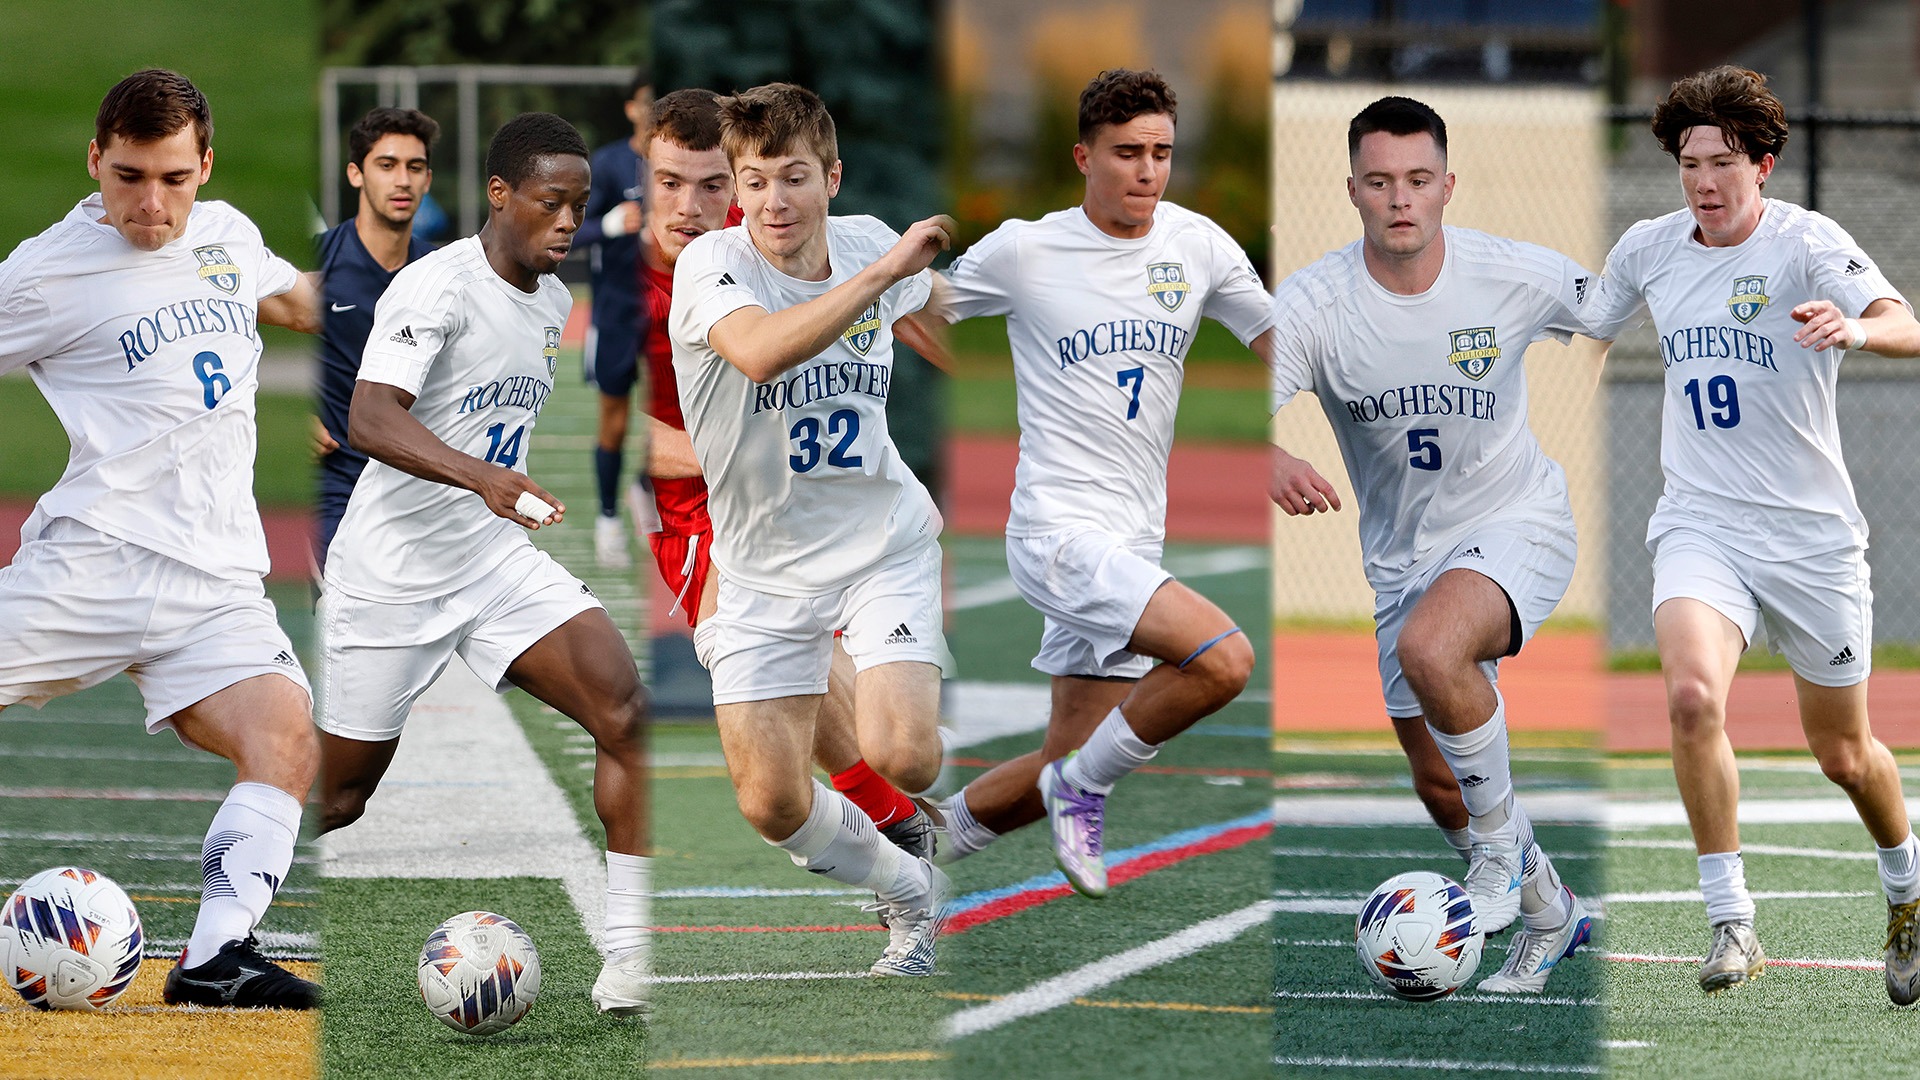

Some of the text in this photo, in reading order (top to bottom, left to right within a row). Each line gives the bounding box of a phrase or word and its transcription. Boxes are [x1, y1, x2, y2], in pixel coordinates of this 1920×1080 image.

[1151, 283, 1186, 291] MELIORA
[1453, 348, 1496, 361] MELIORA
[1659, 326, 1779, 373] OCHESTER
[192, 351, 231, 410] 6
[457, 375, 551, 417] ROCHEST
[752, 362, 889, 415] ROCHESTER
[1117, 367, 1144, 420] 7
[1346, 384, 1496, 423] ROCHESTER
[1684, 375, 1741, 430] 19
[484, 422, 525, 469] 14
[789, 409, 862, 473] 32
[1407, 428, 1442, 471] 5
[885, 635, 918, 645] adidas
